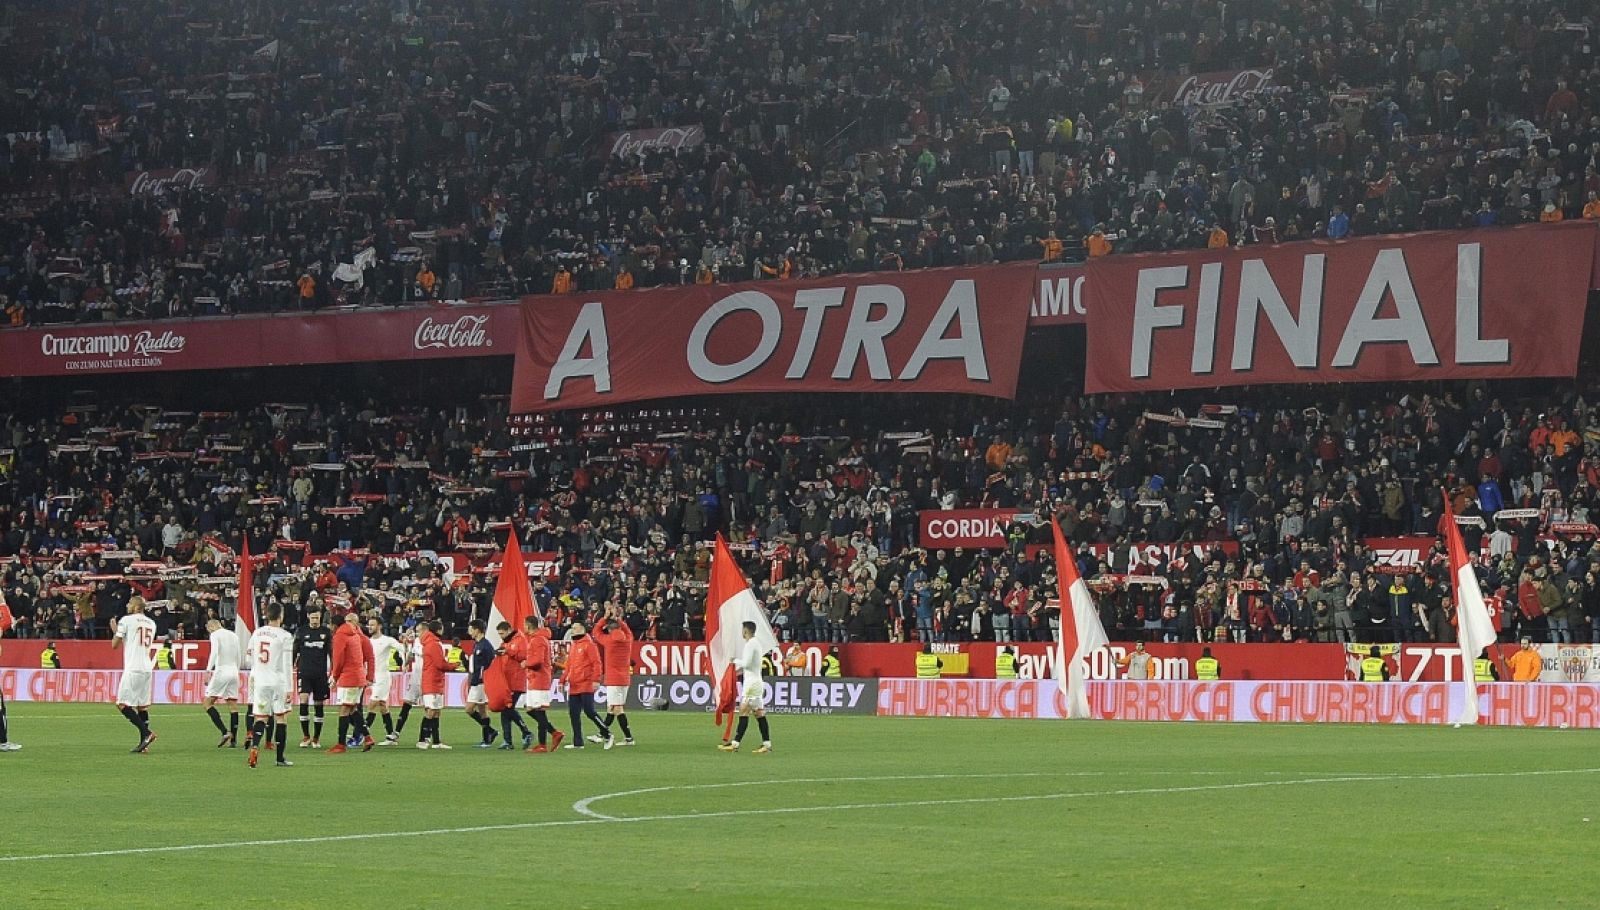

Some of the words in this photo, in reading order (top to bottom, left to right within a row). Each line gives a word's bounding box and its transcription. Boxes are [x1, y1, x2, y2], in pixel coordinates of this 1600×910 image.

[1130, 242, 1510, 379] FINAL
[41, 333, 130, 357] Cruzcampo
[134, 330, 186, 357] Radler
[414, 314, 490, 350] Coca-Cola
[543, 302, 611, 400] A
[686, 278, 990, 383] OTRA
[65, 360, 80, 370] CON
[80, 360, 100, 370] ZUMO
[100, 359, 131, 369] NATURAL
[131, 358, 141, 367] DE
[137, 626, 153, 648] 15
[260, 641, 271, 664] 5
[640, 643, 709, 676] SINC
[1562, 649, 1588, 657] SINCE
[810, 682, 865, 707] REY
[1252, 682, 1449, 724] CHURRUCA
